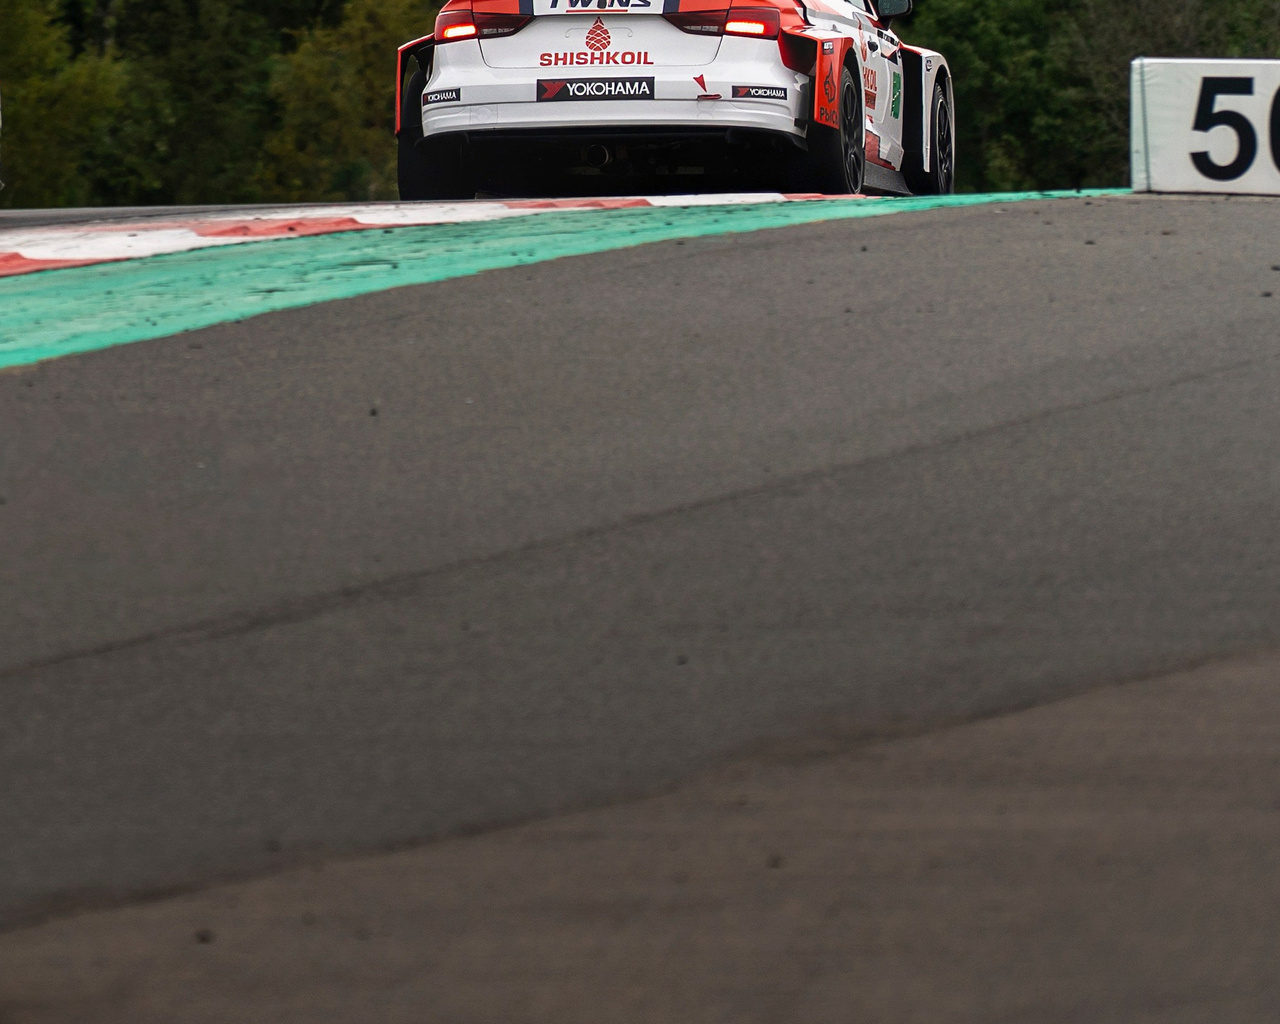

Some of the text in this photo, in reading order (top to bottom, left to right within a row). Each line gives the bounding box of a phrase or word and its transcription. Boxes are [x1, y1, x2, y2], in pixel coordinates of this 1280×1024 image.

[540, 52, 654, 67] SHISHKOIL
[566, 81, 650, 96] YOKOHAMA
[749, 88, 786, 97] YOKOHAMA
[1189, 76, 1280, 182] 5
